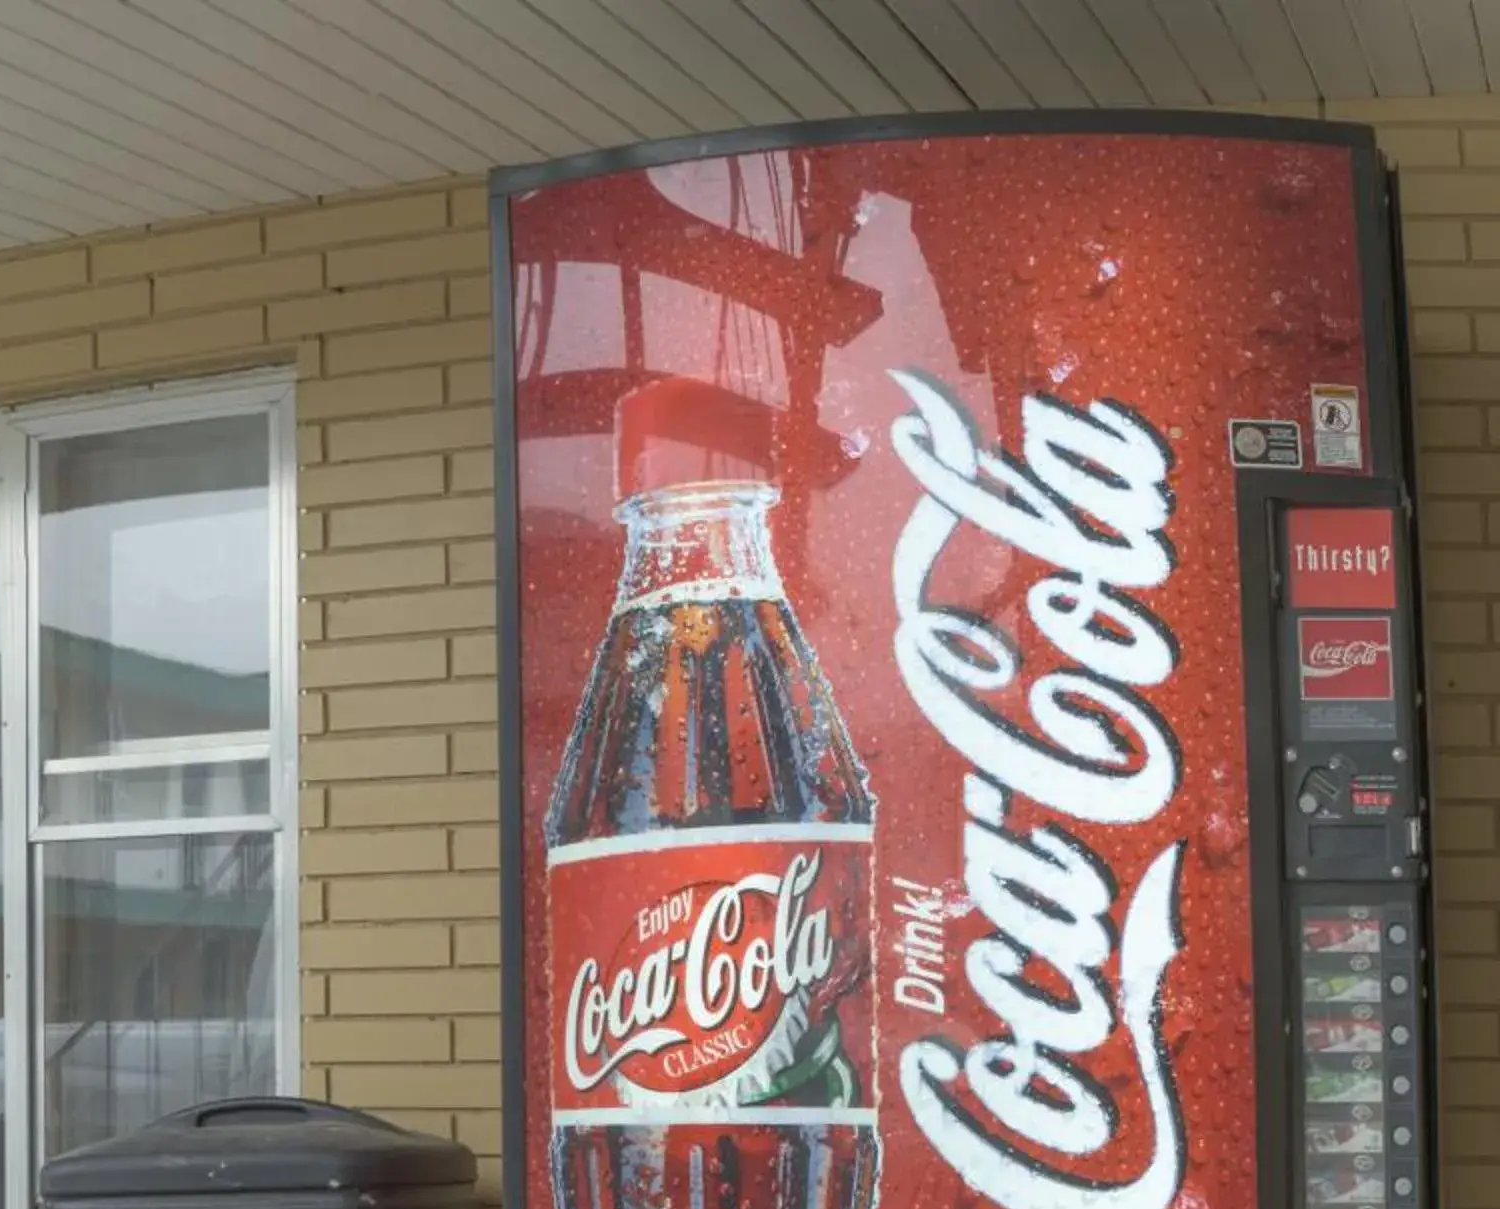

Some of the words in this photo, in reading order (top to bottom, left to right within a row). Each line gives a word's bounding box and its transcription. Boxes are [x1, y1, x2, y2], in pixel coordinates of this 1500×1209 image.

[1295, 544, 1390, 577] Thirsty?
[637, 887, 695, 943] Enjoy
[566, 846, 834, 1091] Coca-Cola
[892, 876, 945, 1015] Drink!
[662, 1022, 752, 1078] CLASSIC
